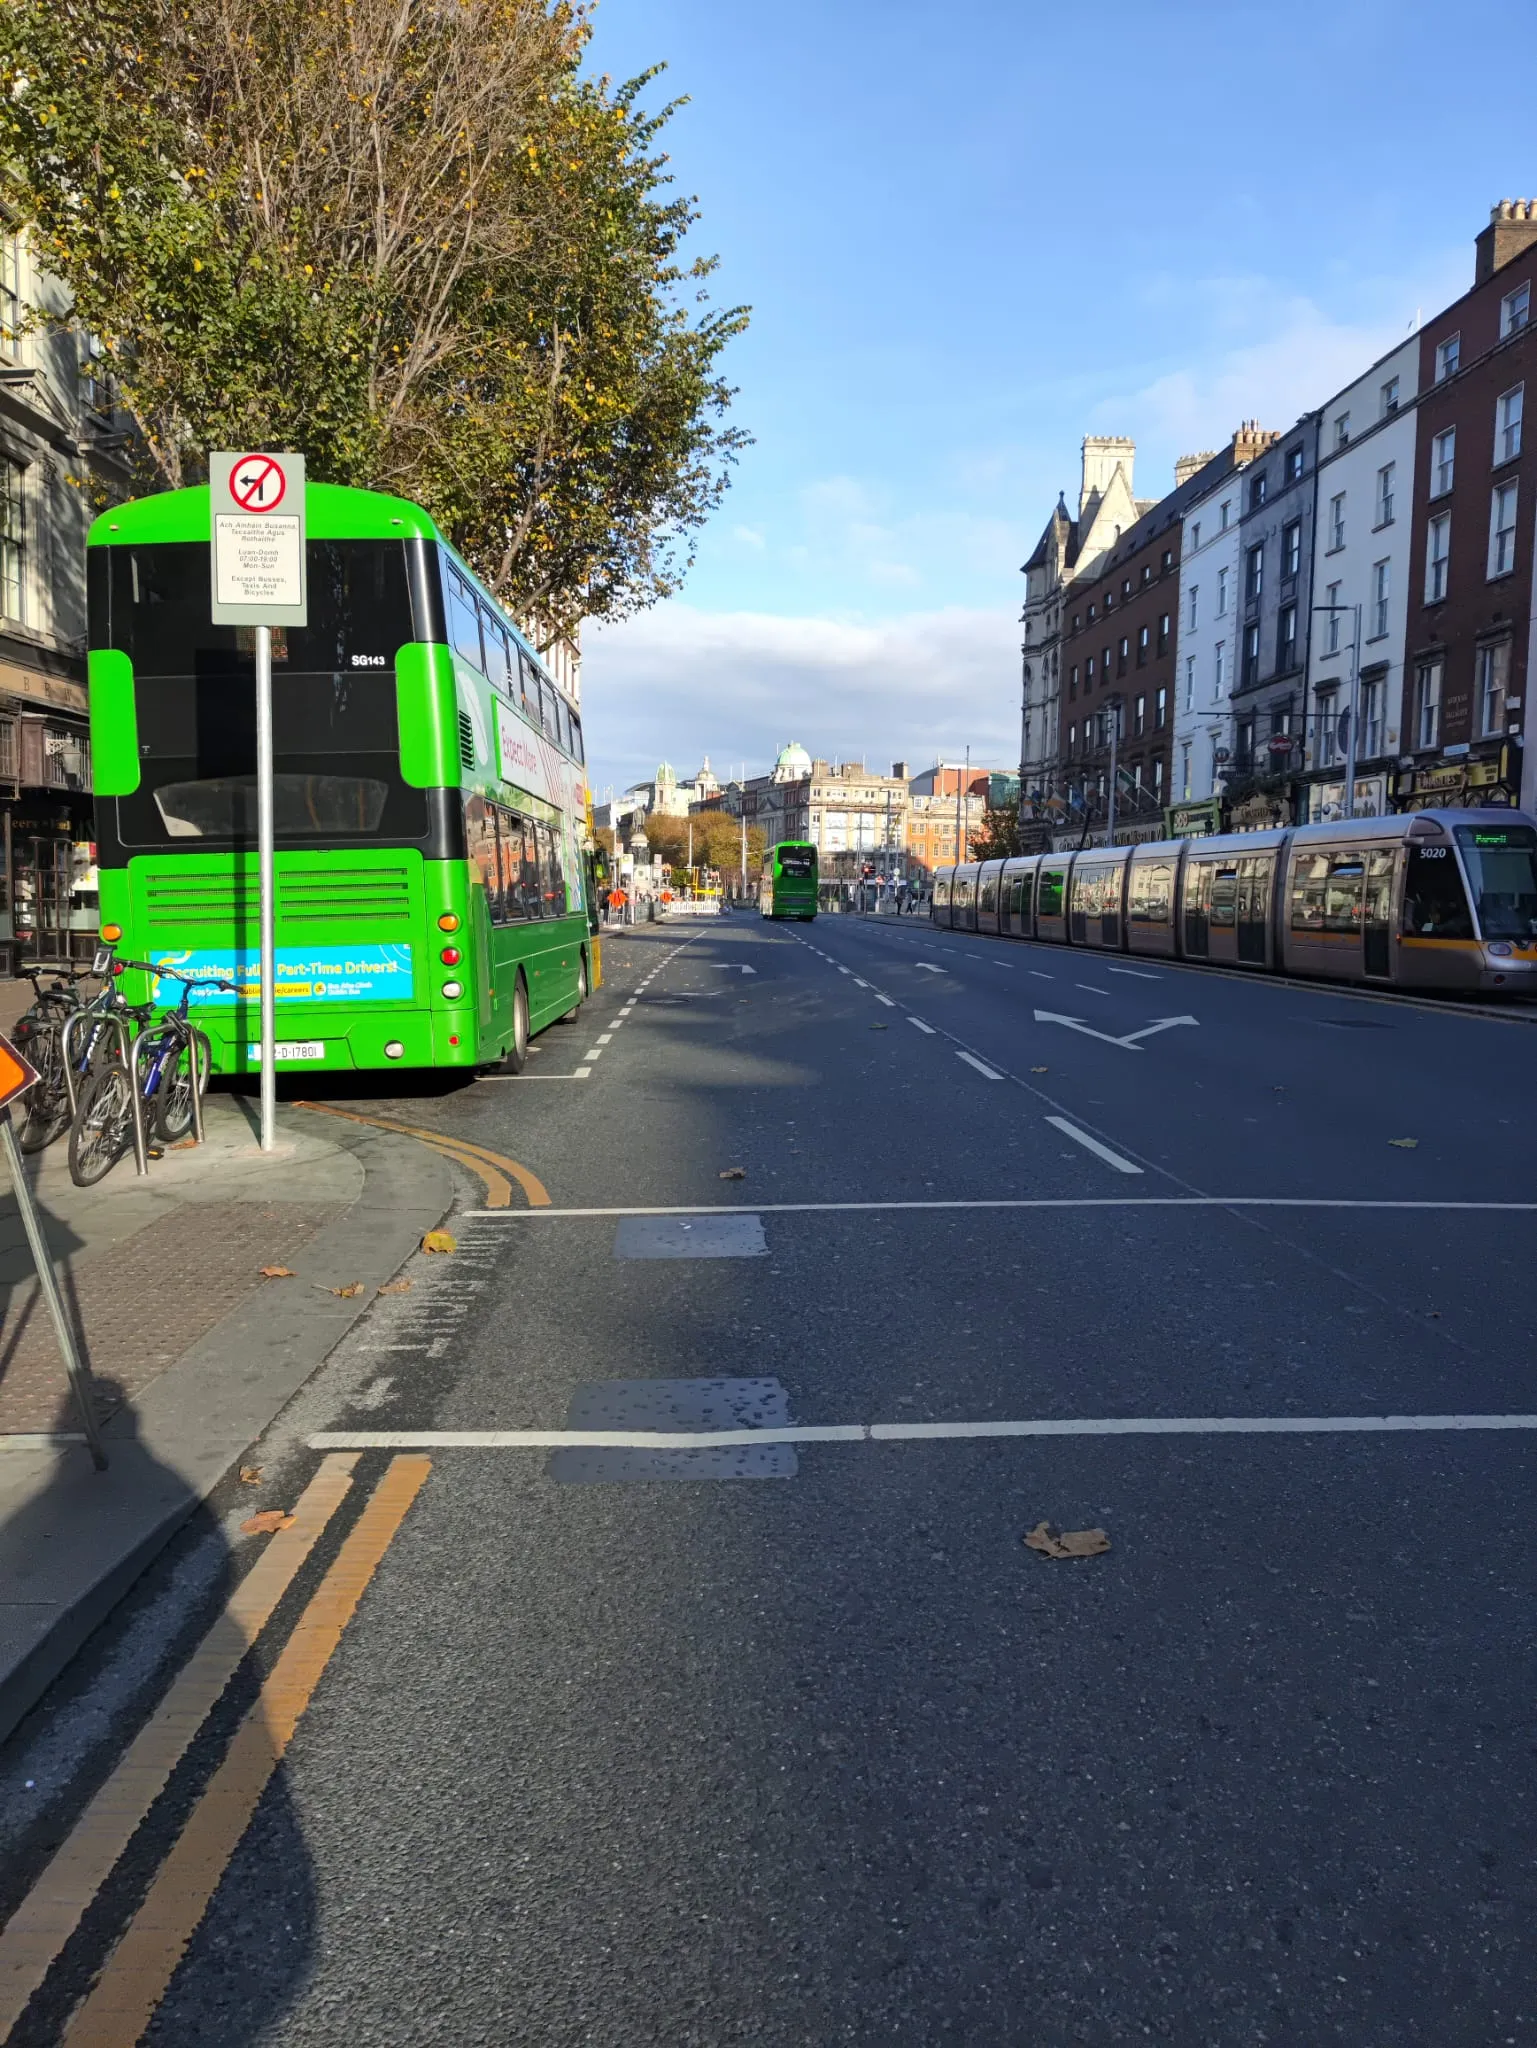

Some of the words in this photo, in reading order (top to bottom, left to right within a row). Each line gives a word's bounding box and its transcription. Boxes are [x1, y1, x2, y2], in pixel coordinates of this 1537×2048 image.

[244, 589, 274, 597] Bicycles
[352, 655, 385, 666] SG143
[1420, 848, 1446, 859] 5020
[277, 961, 342, 976] Part-Time
[344, 959, 398, 974] Drivers!
